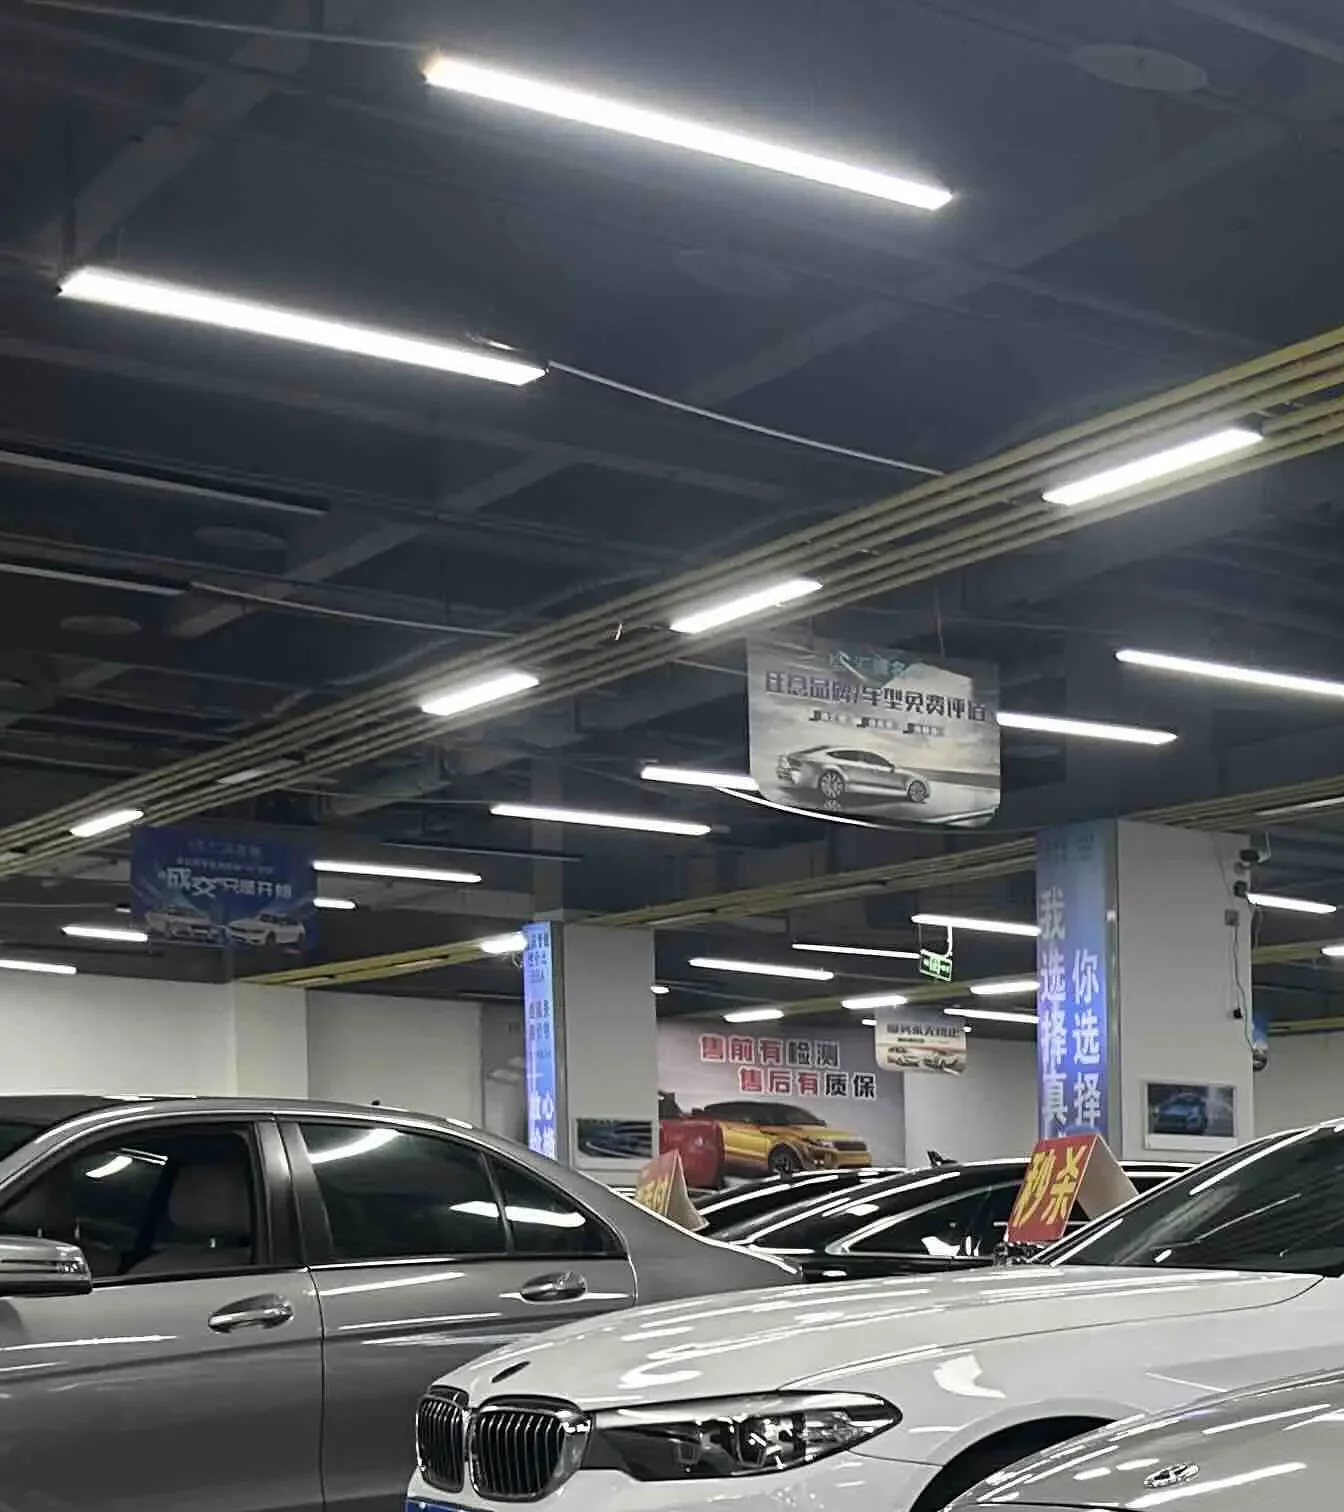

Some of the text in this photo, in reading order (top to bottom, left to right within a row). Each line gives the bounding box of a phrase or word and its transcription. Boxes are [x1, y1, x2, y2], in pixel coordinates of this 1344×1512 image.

[700, 1034, 840, 1069] 售前有检测
[738, 1068, 877, 1100] 售后有质保
[1012, 1144, 1087, 1227] 秒杀
